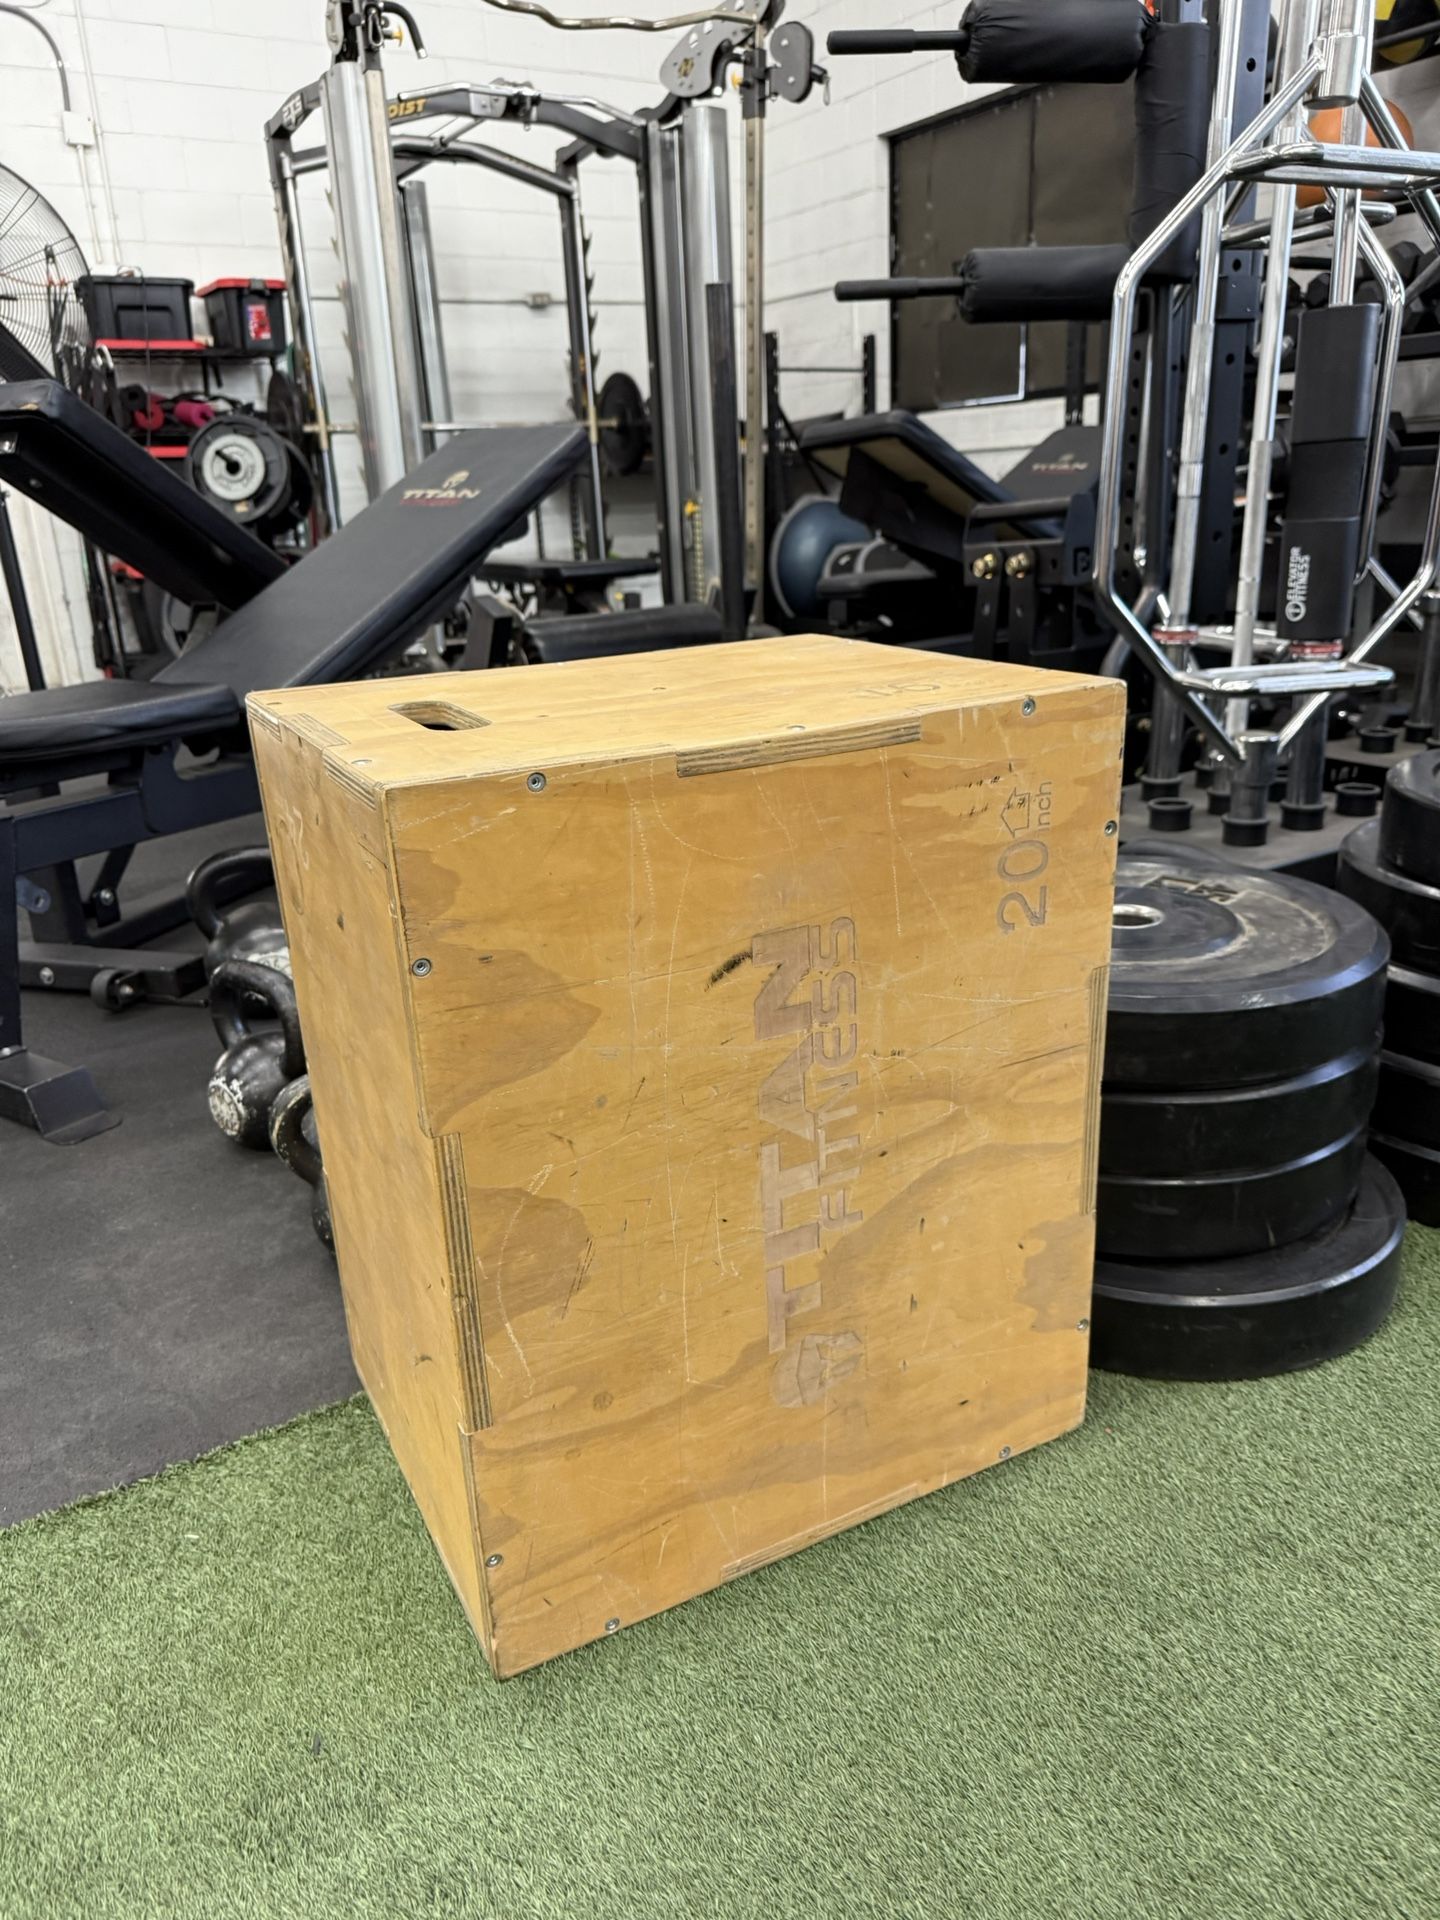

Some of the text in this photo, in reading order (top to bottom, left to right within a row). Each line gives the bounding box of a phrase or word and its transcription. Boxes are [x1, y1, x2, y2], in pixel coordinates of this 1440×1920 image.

[388, 98, 426, 118] OIST
[404, 489, 481, 499] TITAN
[1286, 547, 1301, 600] ELEVATOR
[1295, 555, 1310, 601] FITNESS
[996, 781, 1053, 934] 20 inch
[811, 916, 863, 1233] FITNESS
[752, 925, 823, 1354] TITAN
